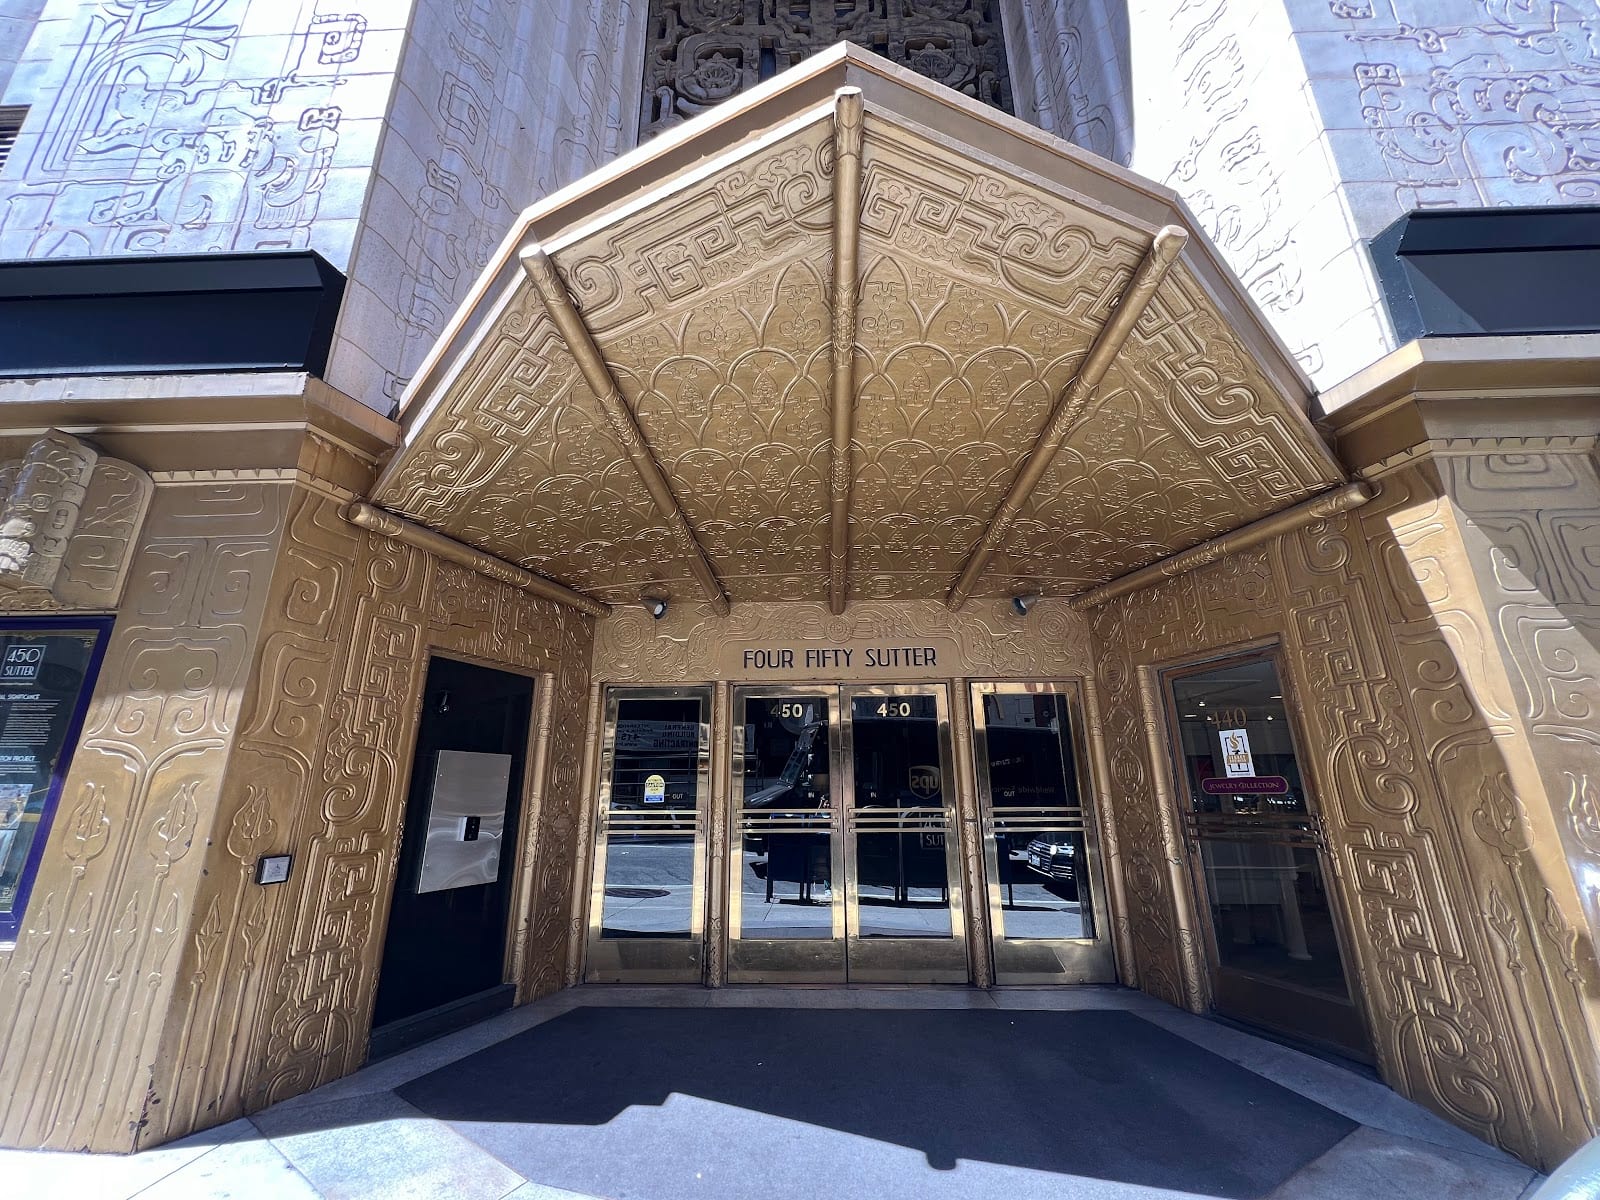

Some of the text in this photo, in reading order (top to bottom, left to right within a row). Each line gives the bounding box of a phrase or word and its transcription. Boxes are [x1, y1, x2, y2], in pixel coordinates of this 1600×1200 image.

[7, 648, 40, 663] 450
[743, 647, 937, 668] FOUR FIFTY SUTTER
[3, 665, 35, 676] SUTTER
[770, 703, 803, 718] 450
[876, 702, 911, 718] 450
[1210, 706, 1247, 730] 440
[1238, 782, 1279, 790] COLLECTION
